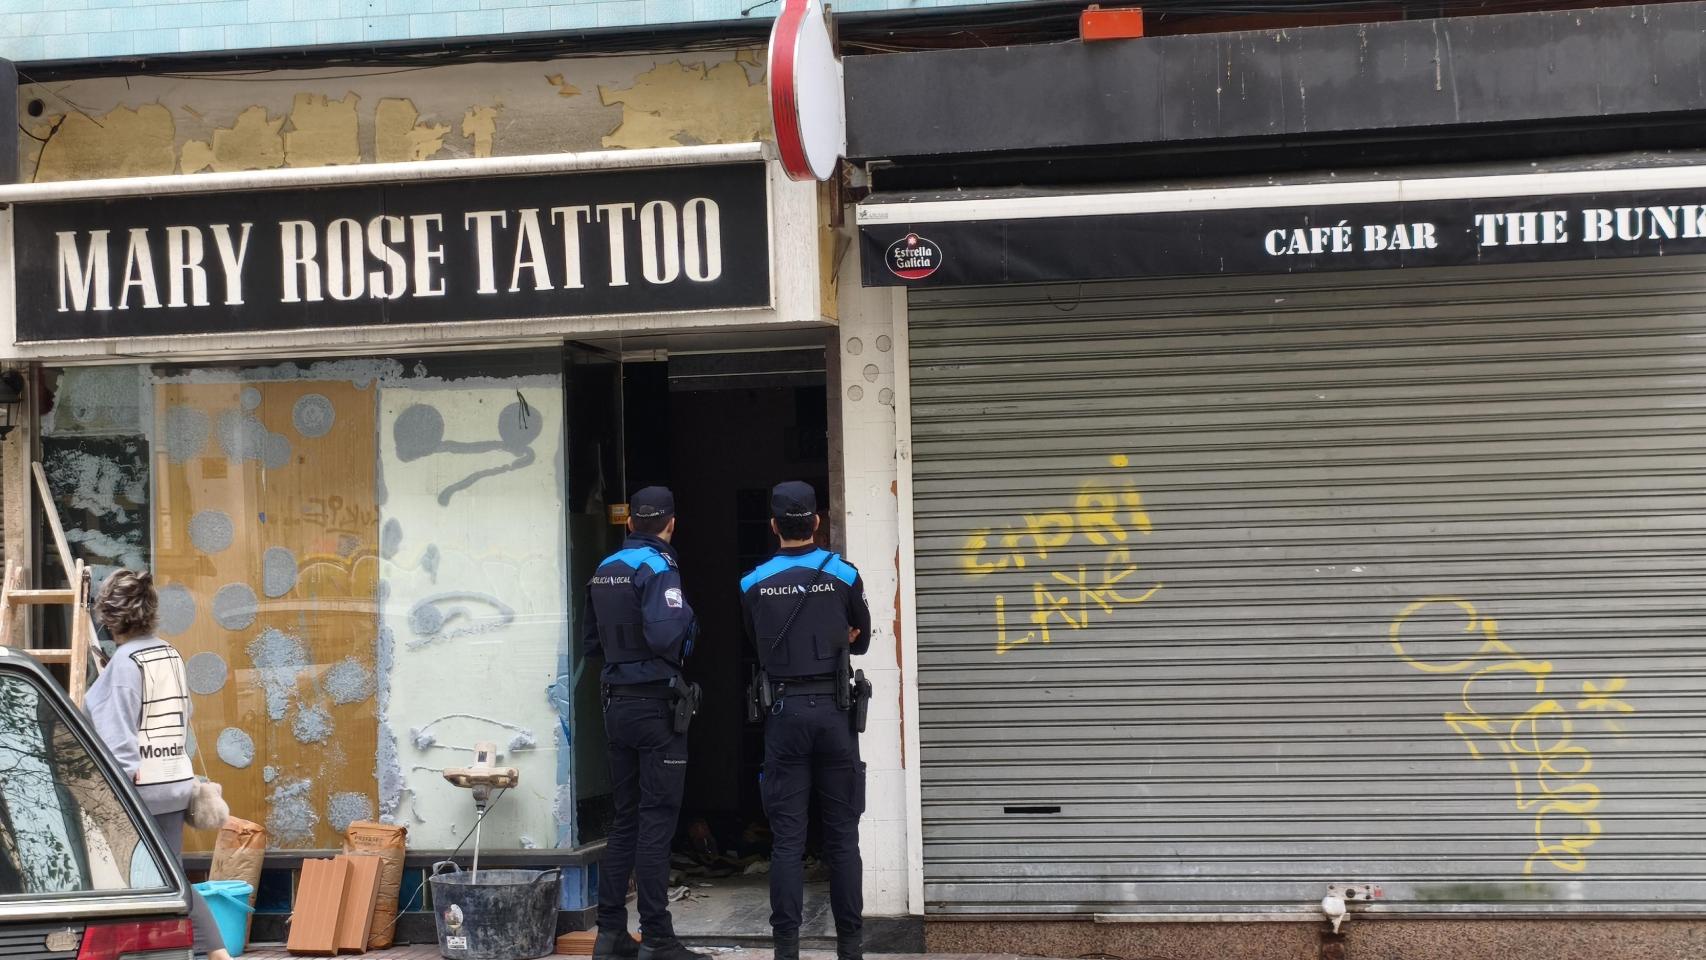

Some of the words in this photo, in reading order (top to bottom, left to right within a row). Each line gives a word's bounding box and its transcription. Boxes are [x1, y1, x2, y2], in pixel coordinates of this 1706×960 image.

[1264, 219, 1353, 256] CAFÉ
[1363, 222, 1439, 252] BAR
[1475, 210, 1569, 247] THE
[1582, 205, 1706, 242] BUNK
[56, 222, 254, 312] MARY
[279, 213, 446, 302] ROSE
[464, 197, 722, 294] TATTOO
[894, 246, 932, 258] Estrella
[896, 256, 931, 269] Galicia
[760, 584, 799, 596] POLICÍA
